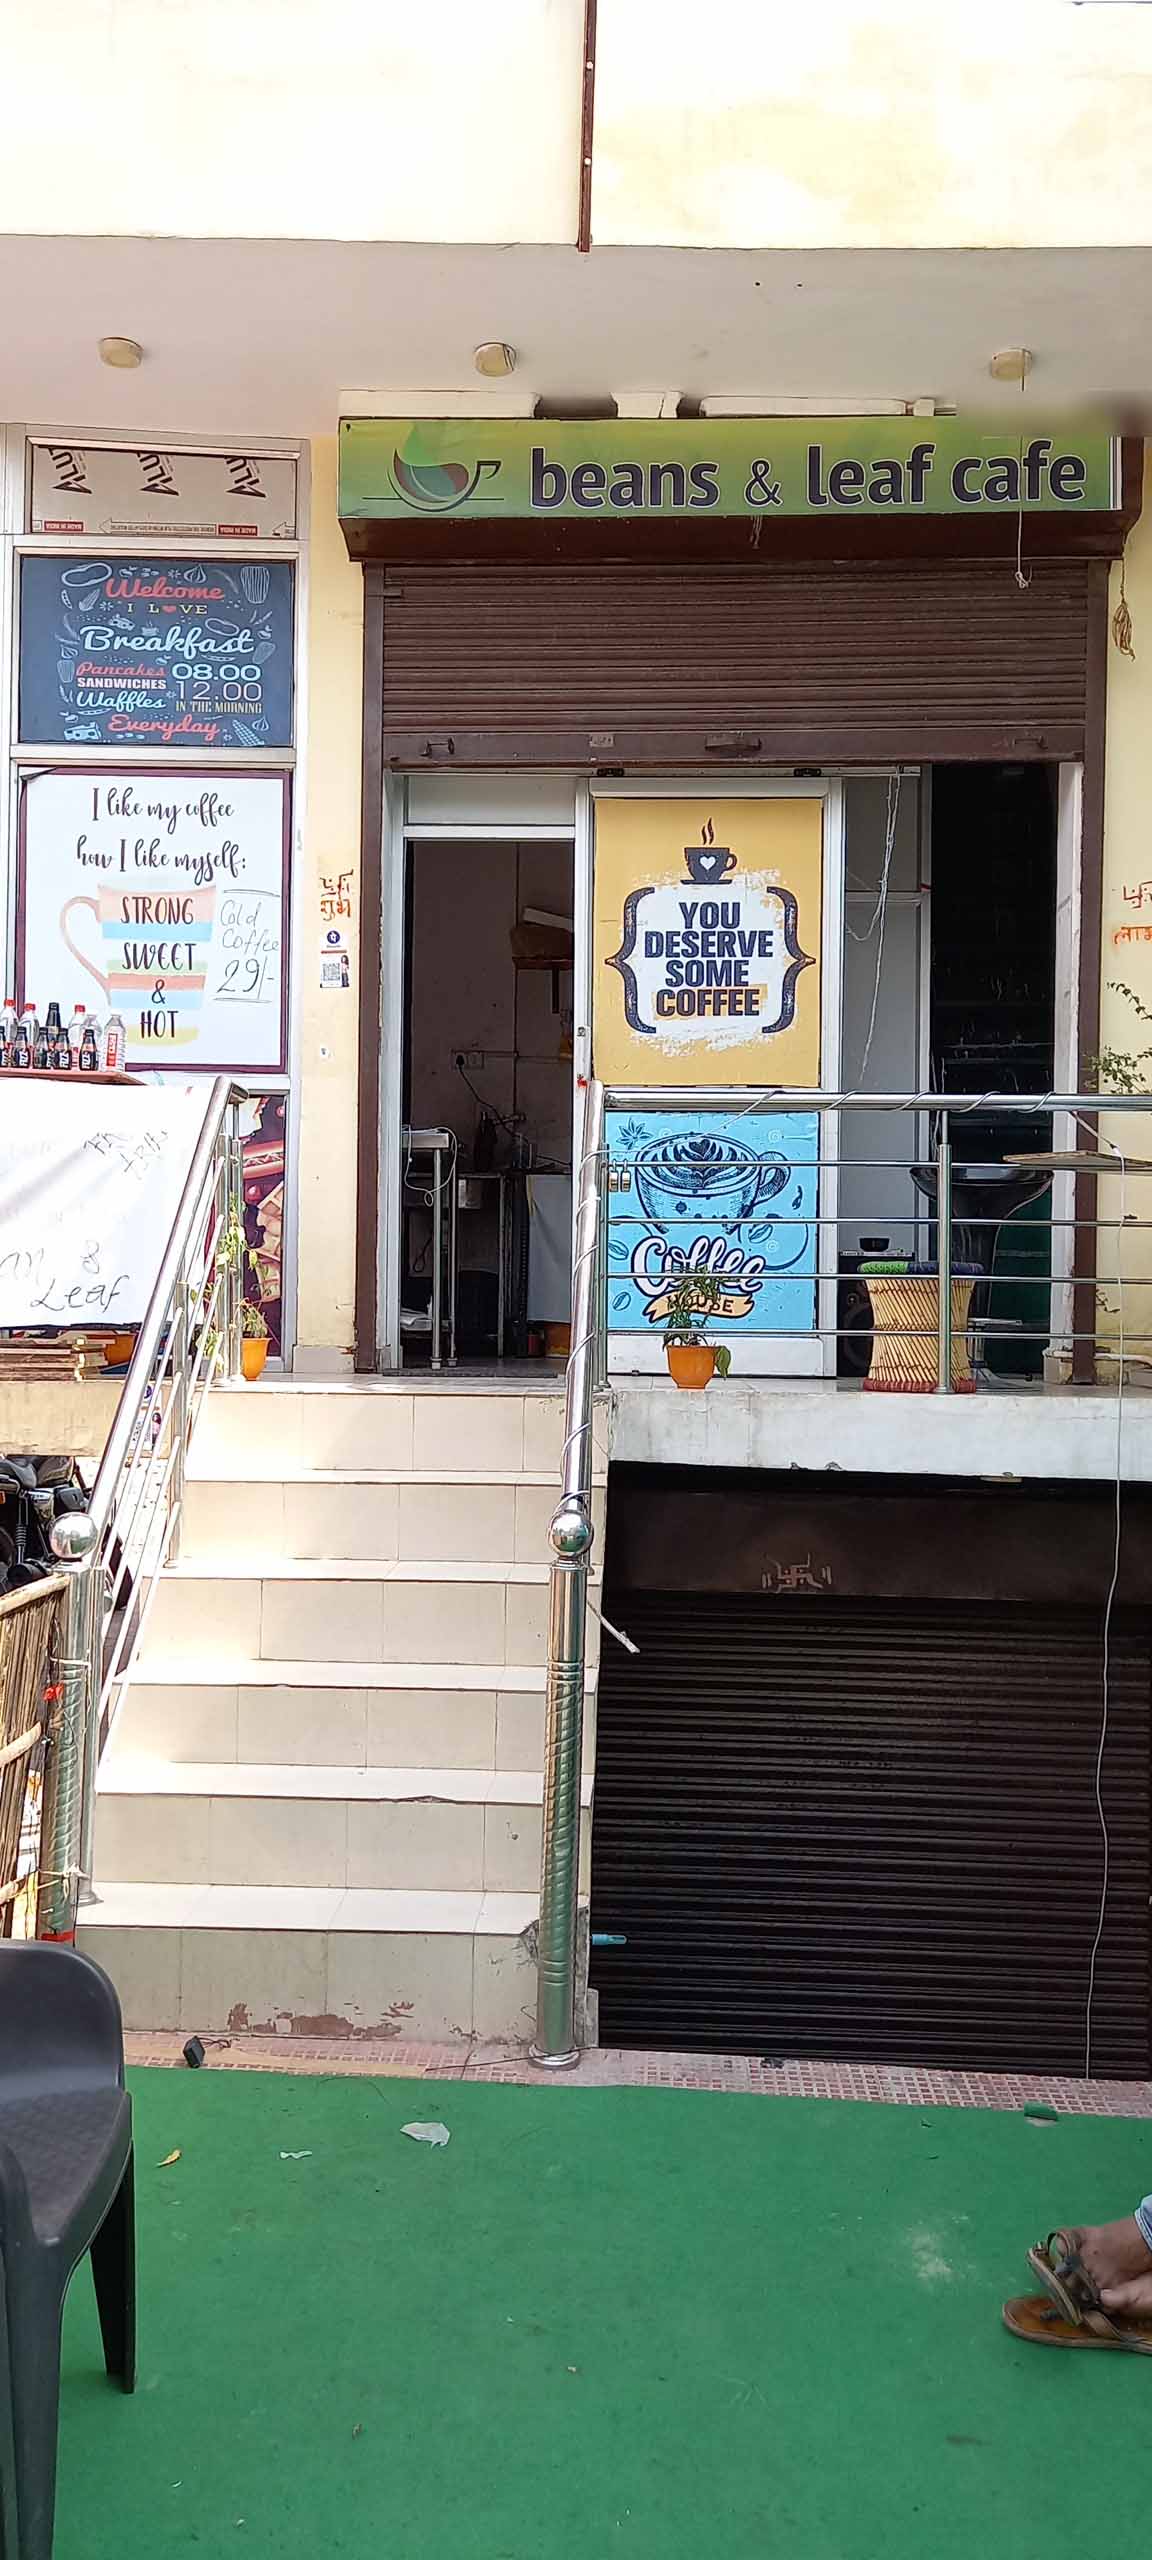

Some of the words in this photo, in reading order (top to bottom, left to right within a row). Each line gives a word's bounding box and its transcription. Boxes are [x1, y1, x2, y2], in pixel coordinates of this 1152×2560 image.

[530, 446, 720, 510] beans
[743, 458, 784, 507] &
[805, 442, 937, 507] leaf
[951, 438, 1087, 503] cafe
[105, 576, 225, 600] Welcome
[79, 625, 254, 659] Breakfast
[76, 662, 166, 677] Pancakes
[77, 677, 167, 689] SANDWICHES
[171, 664, 261, 681] 08.00
[76, 690, 166, 712] Waffles
[176, 681, 262, 701] 12.00
[176, 702, 186, 713] IN
[189, 702, 211, 713] THE
[214, 702, 262, 713] MORNING
[108, 714, 220, 741] Everyday
[92, 787, 99, 821] I
[107, 787, 143, 817] like
[147, 803, 181, 835] my
[185, 792, 235, 827] coffee
[76, 835, 115, 868] how
[119, 839, 126, 872] I
[134, 838, 170, 868] like
[174, 840, 247, 886] myself:
[120, 896, 194, 925] STRONG
[220, 899, 262, 928] Cold
[678, 901, 741, 929] YOU
[222, 928, 280, 956] Coffee
[644, 930, 774, 958] DESERVE
[122, 942, 197, 971] SWEET
[664, 959, 749, 987] SOME
[151, 979, 166, 1005] &
[655, 988, 760, 1017] COFFEE
[140, 1010, 179, 1039] HOT
[631, 1234, 767, 1298] Coffee
